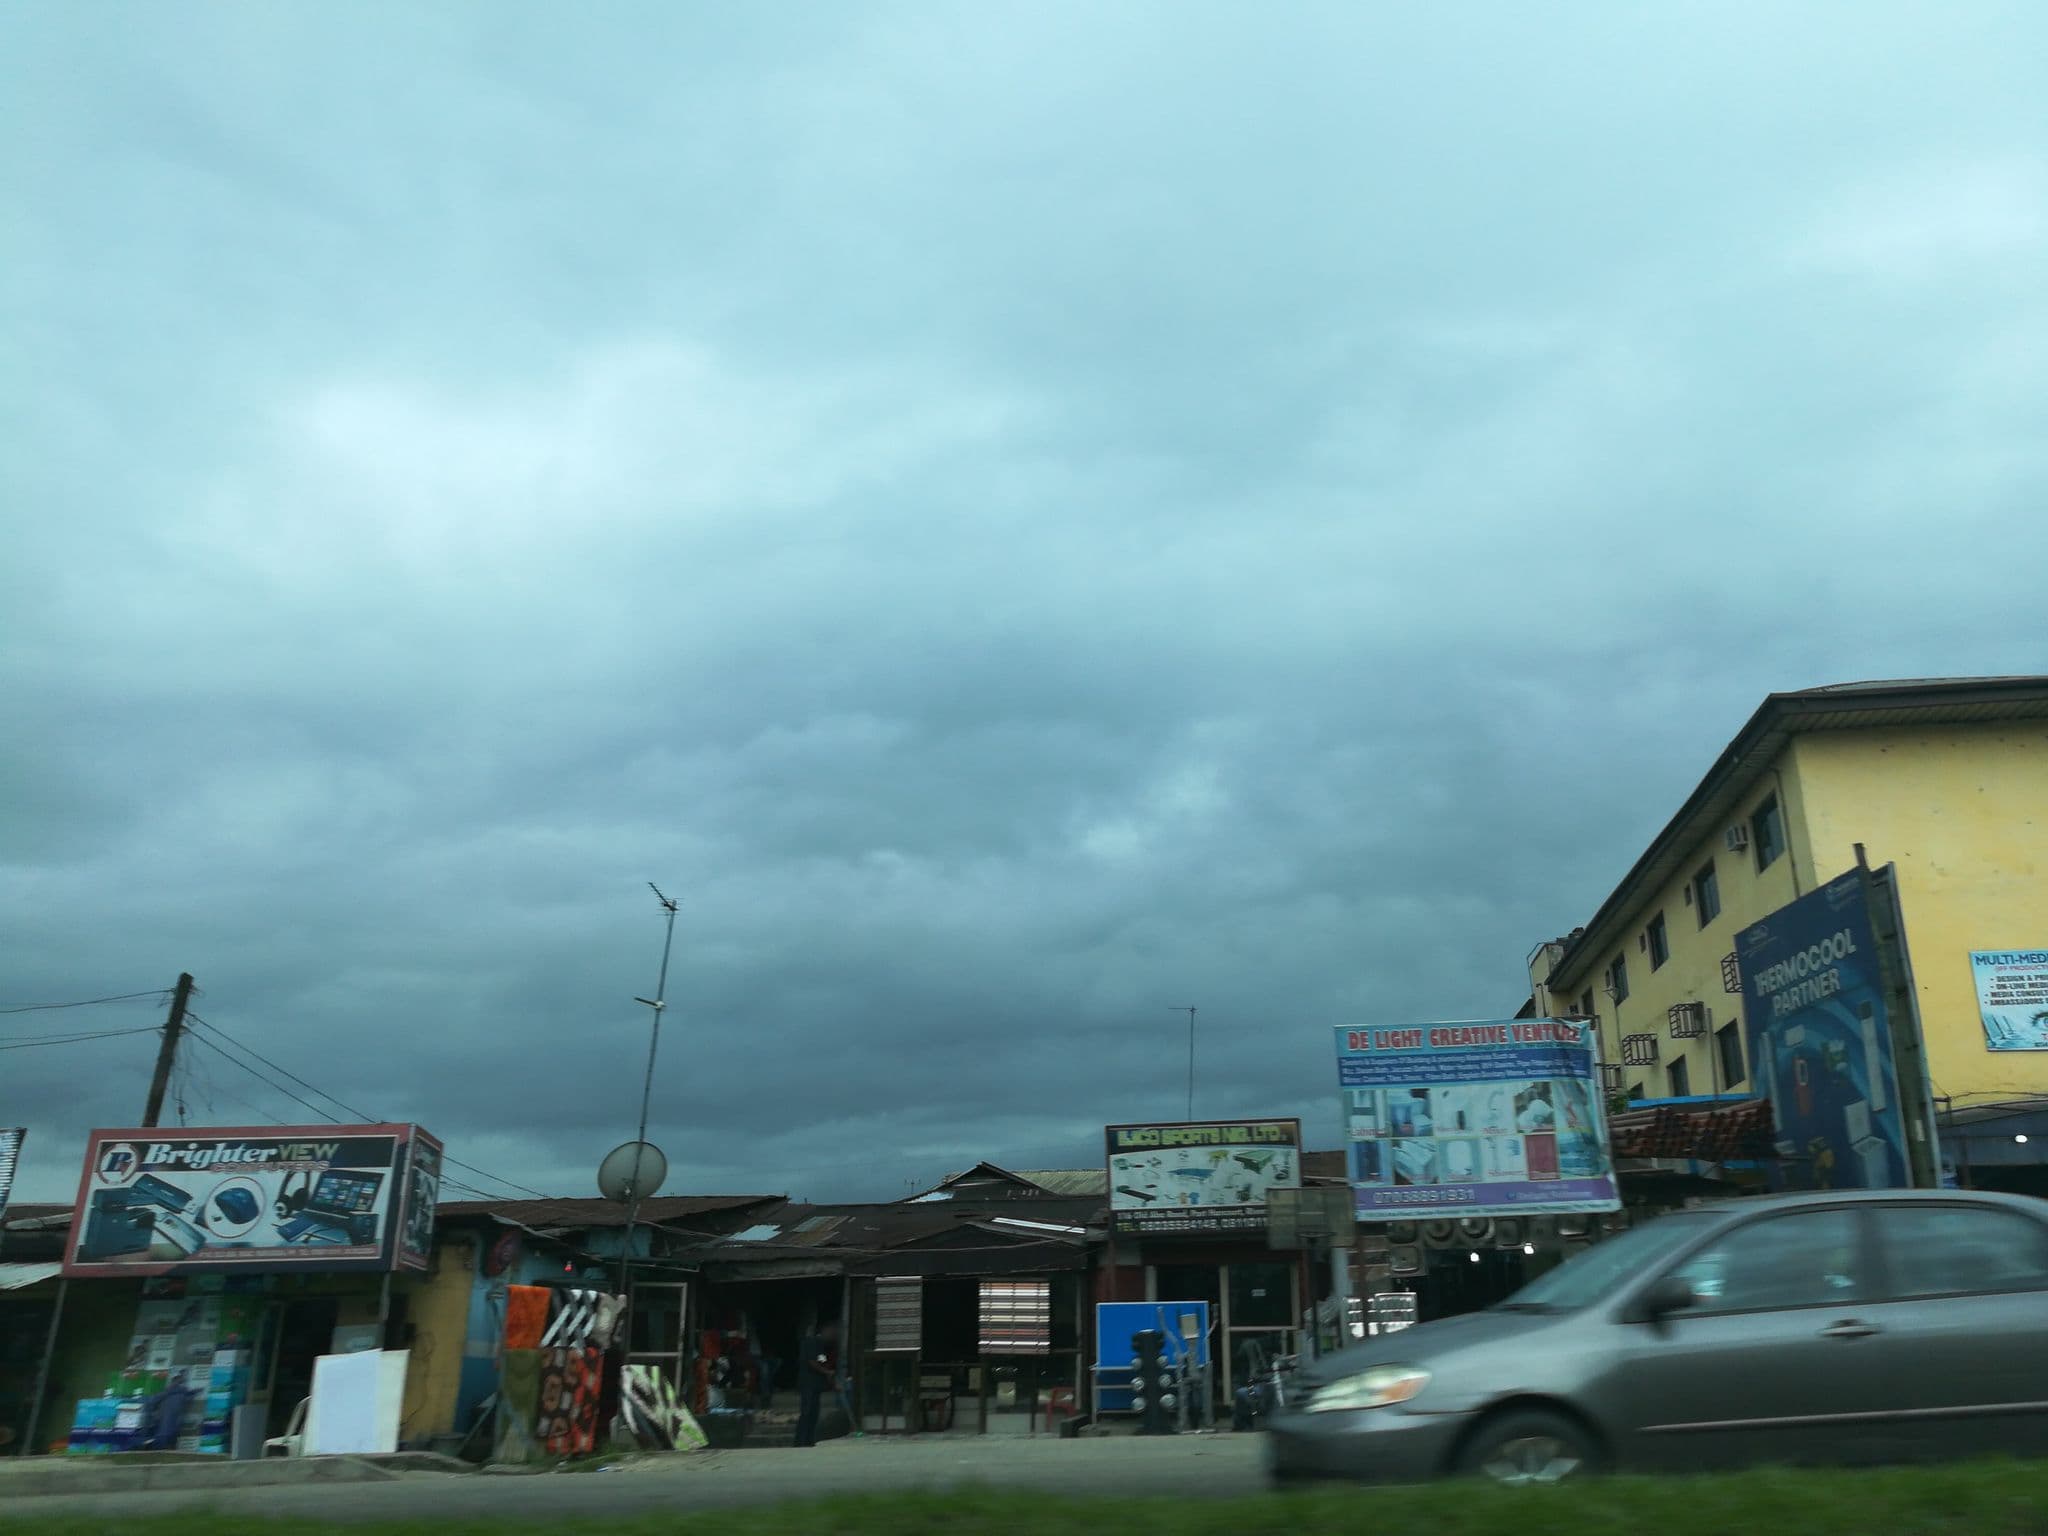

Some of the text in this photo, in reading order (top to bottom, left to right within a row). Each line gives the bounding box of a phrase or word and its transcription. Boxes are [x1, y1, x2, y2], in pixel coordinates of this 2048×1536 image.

[1772, 968, 1841, 1017] PARTNER
[1347, 1030, 1371, 1051] DE
[1374, 1027, 1424, 1050] LIGHT
[1429, 1022, 1508, 1048] CREATIVE
[142, 1142, 341, 1169] Brighter VIEW
[210, 1160, 331, 1173] COMPUTERS
